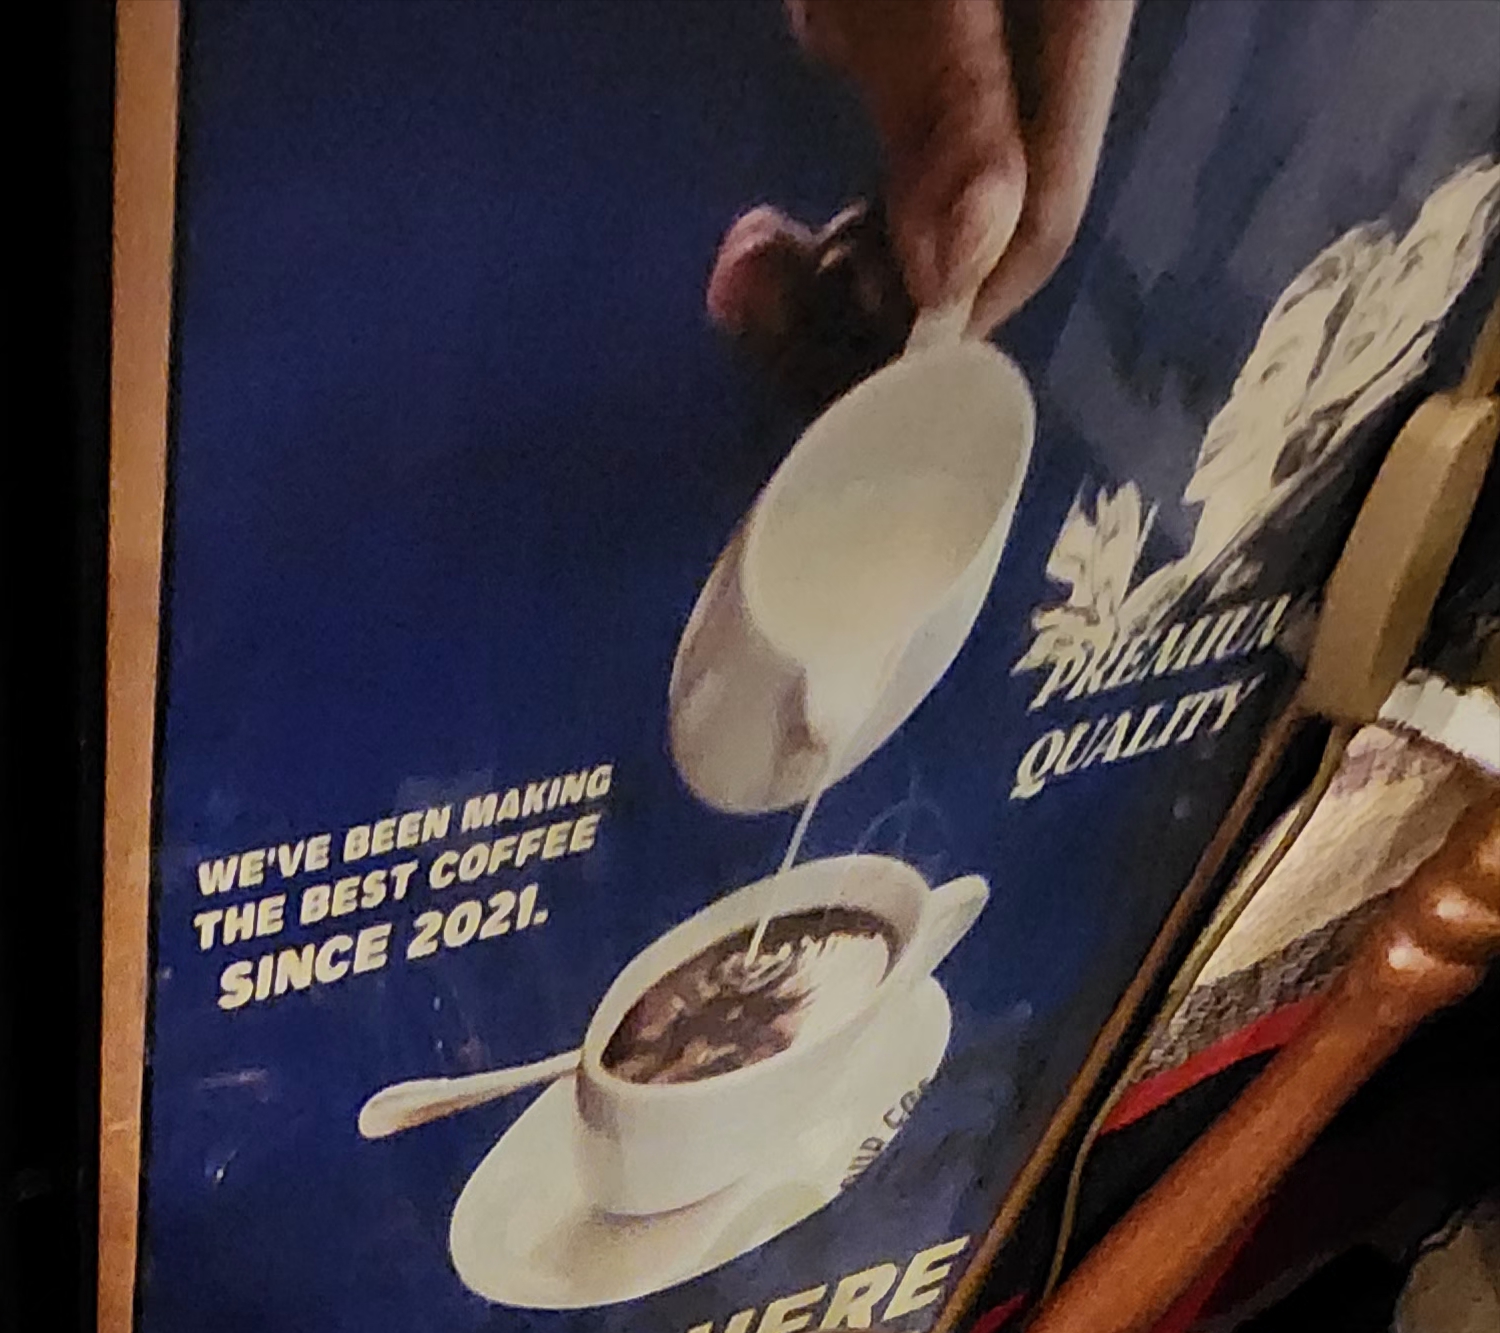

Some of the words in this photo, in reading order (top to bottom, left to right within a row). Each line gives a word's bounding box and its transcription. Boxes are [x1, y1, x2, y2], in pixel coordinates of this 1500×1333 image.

[1009, 672, 1266, 800] QUALITY
[194, 894, 287, 951] THE
[300, 862, 417, 926] BEST
[429, 814, 601, 890] COFFEE
[197, 833, 332, 896] WE'VE
[342, 806, 451, 865] BEEN
[460, 764, 614, 832] MAKING
[217, 923, 392, 1011] SINCE
[407, 883, 550, 960] 2021.
